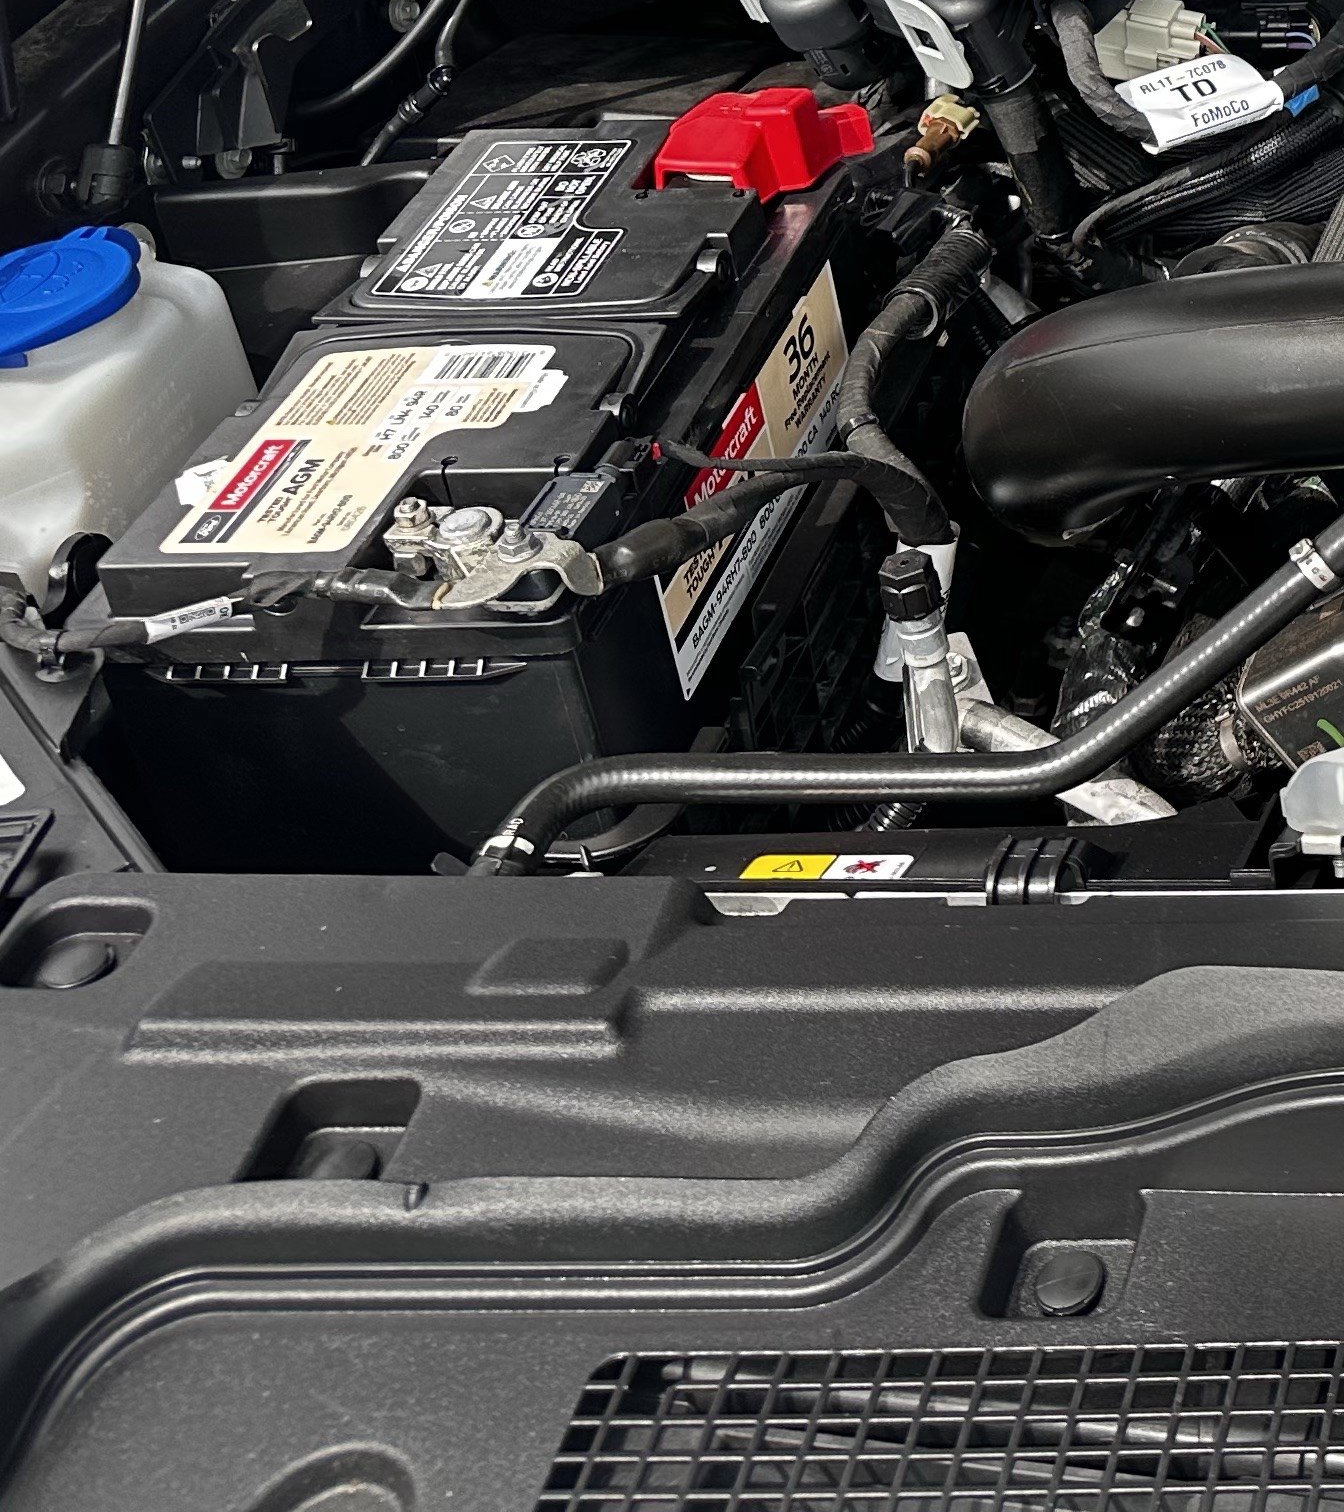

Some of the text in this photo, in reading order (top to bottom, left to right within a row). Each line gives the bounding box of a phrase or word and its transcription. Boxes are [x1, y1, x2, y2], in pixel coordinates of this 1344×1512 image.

[1170, 78, 1217, 102] TD
[1191, 99, 1250, 127] FoMoCo
[783, 313, 815, 384] 36
[792, 351, 818, 400] MONTH
[795, 375, 827, 428] WARRANTY
[221, 444, 284, 506] Motorcraft
[282, 458, 325, 496] AGM
[694, 406, 758, 505] Motrcraft
